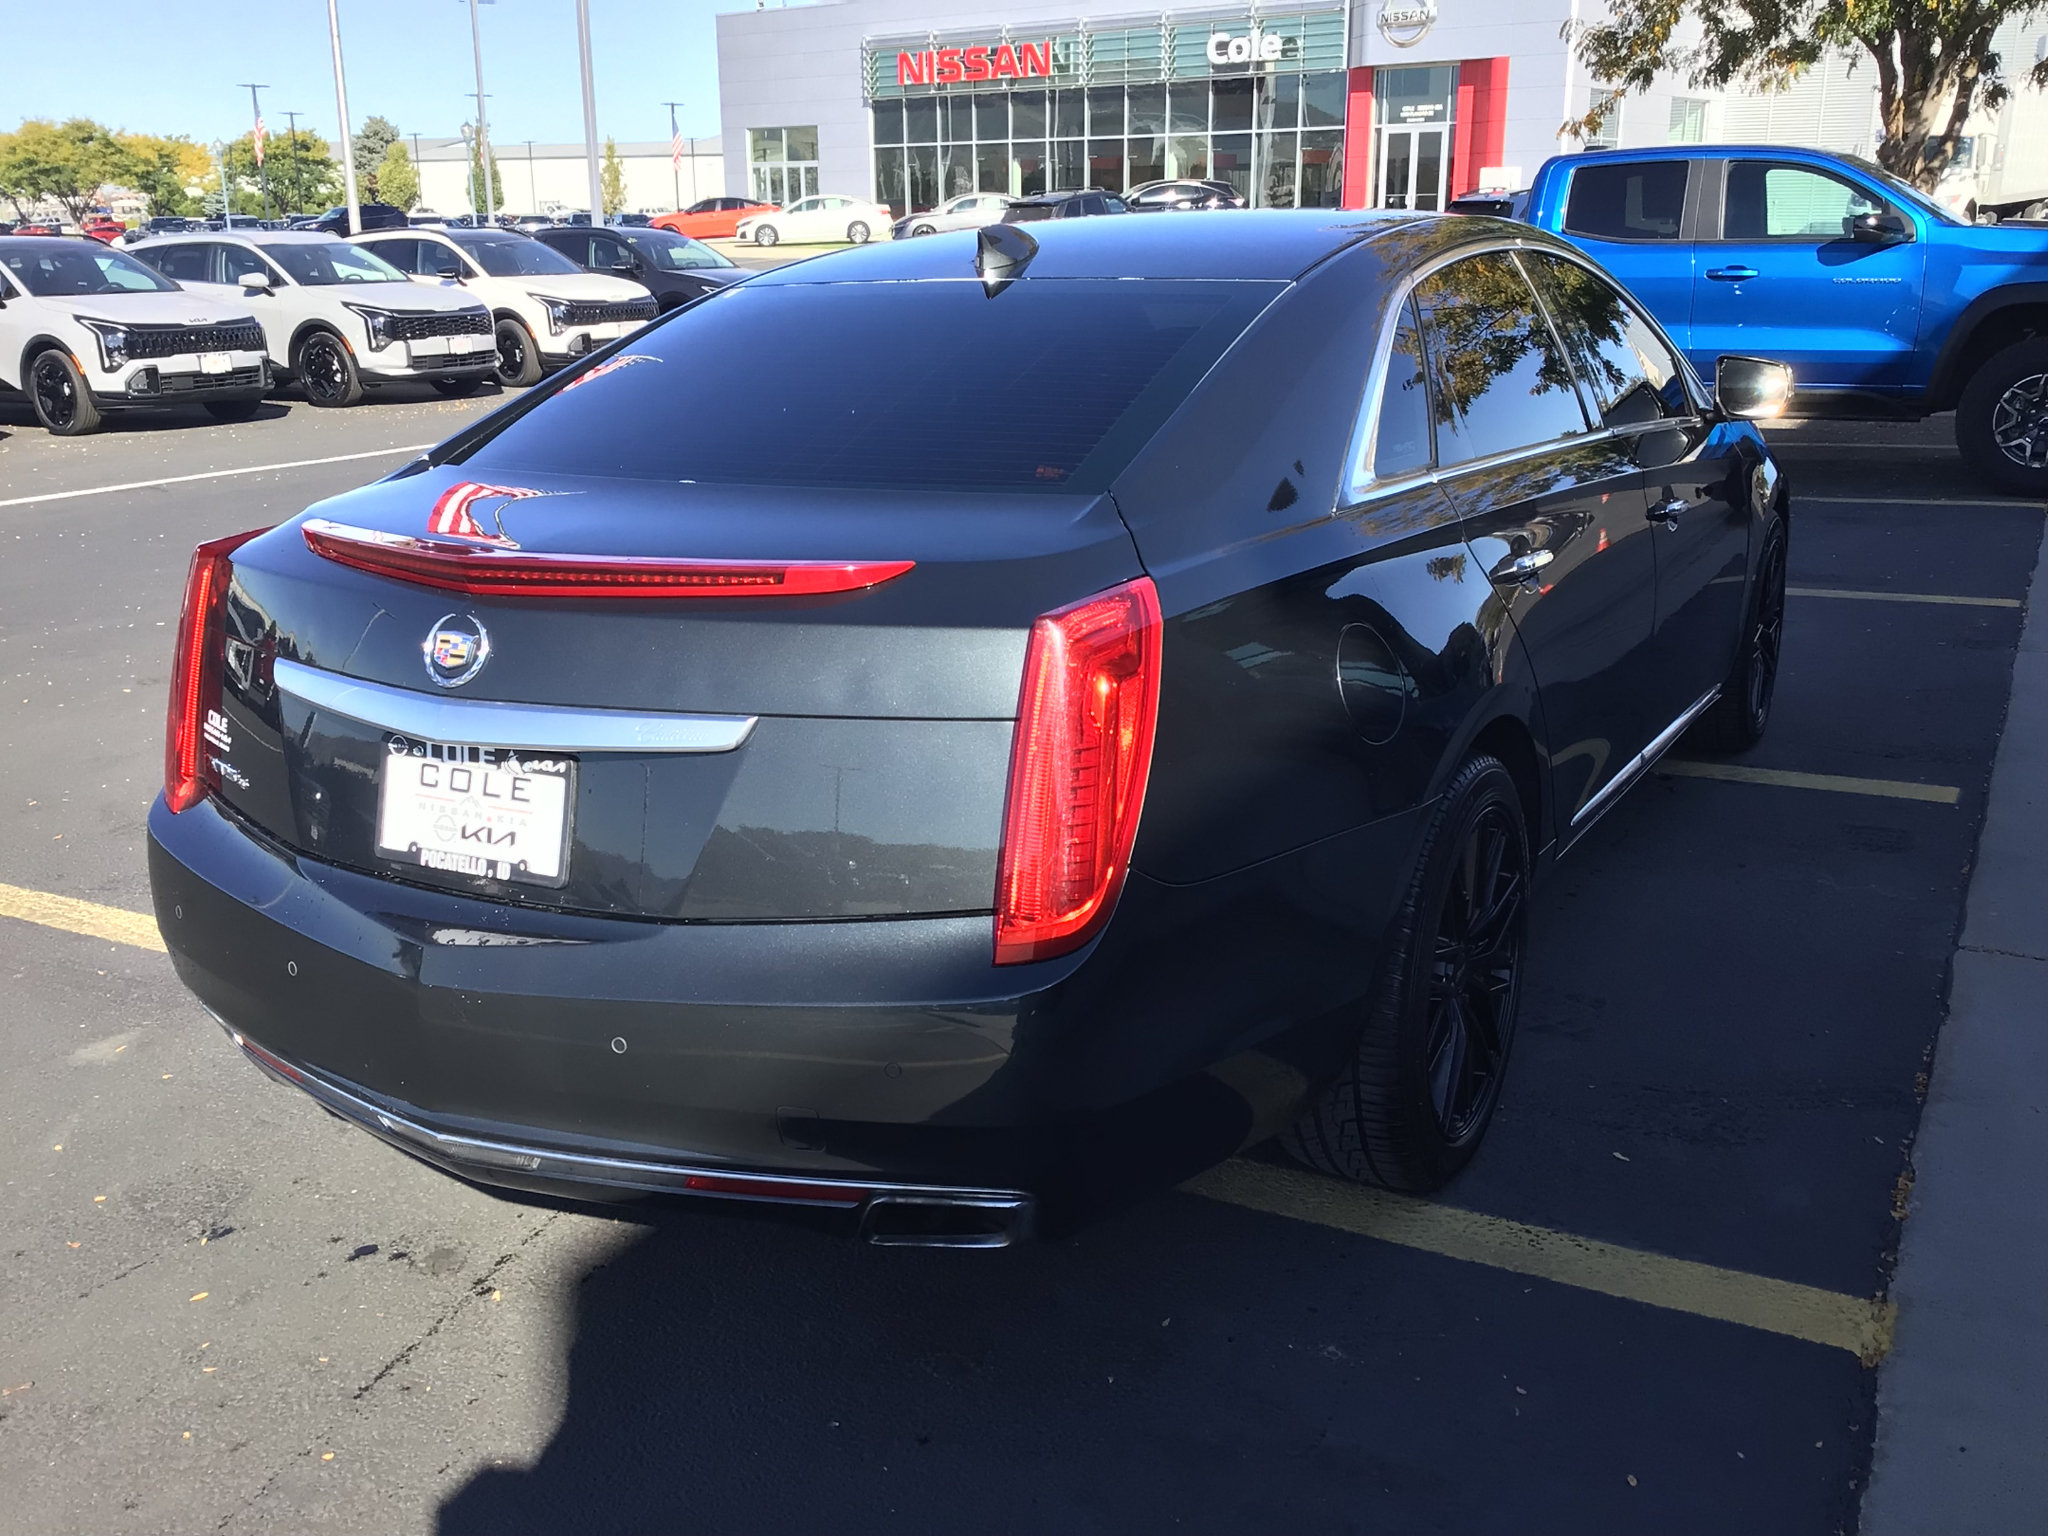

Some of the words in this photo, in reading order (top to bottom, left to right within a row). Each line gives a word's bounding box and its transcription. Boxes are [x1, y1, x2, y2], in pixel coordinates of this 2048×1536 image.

[1380, 9, 1430, 23] NISSAN
[1207, 27, 1283, 65] Cole
[897, 41, 1051, 86] NISSAN
[420, 763, 532, 803] COLE
[418, 802, 483, 820] NISSAN
[497, 815, 527, 827] KIA
[461, 824, 517, 847] KIA
[496, 861, 512, 881] ID
